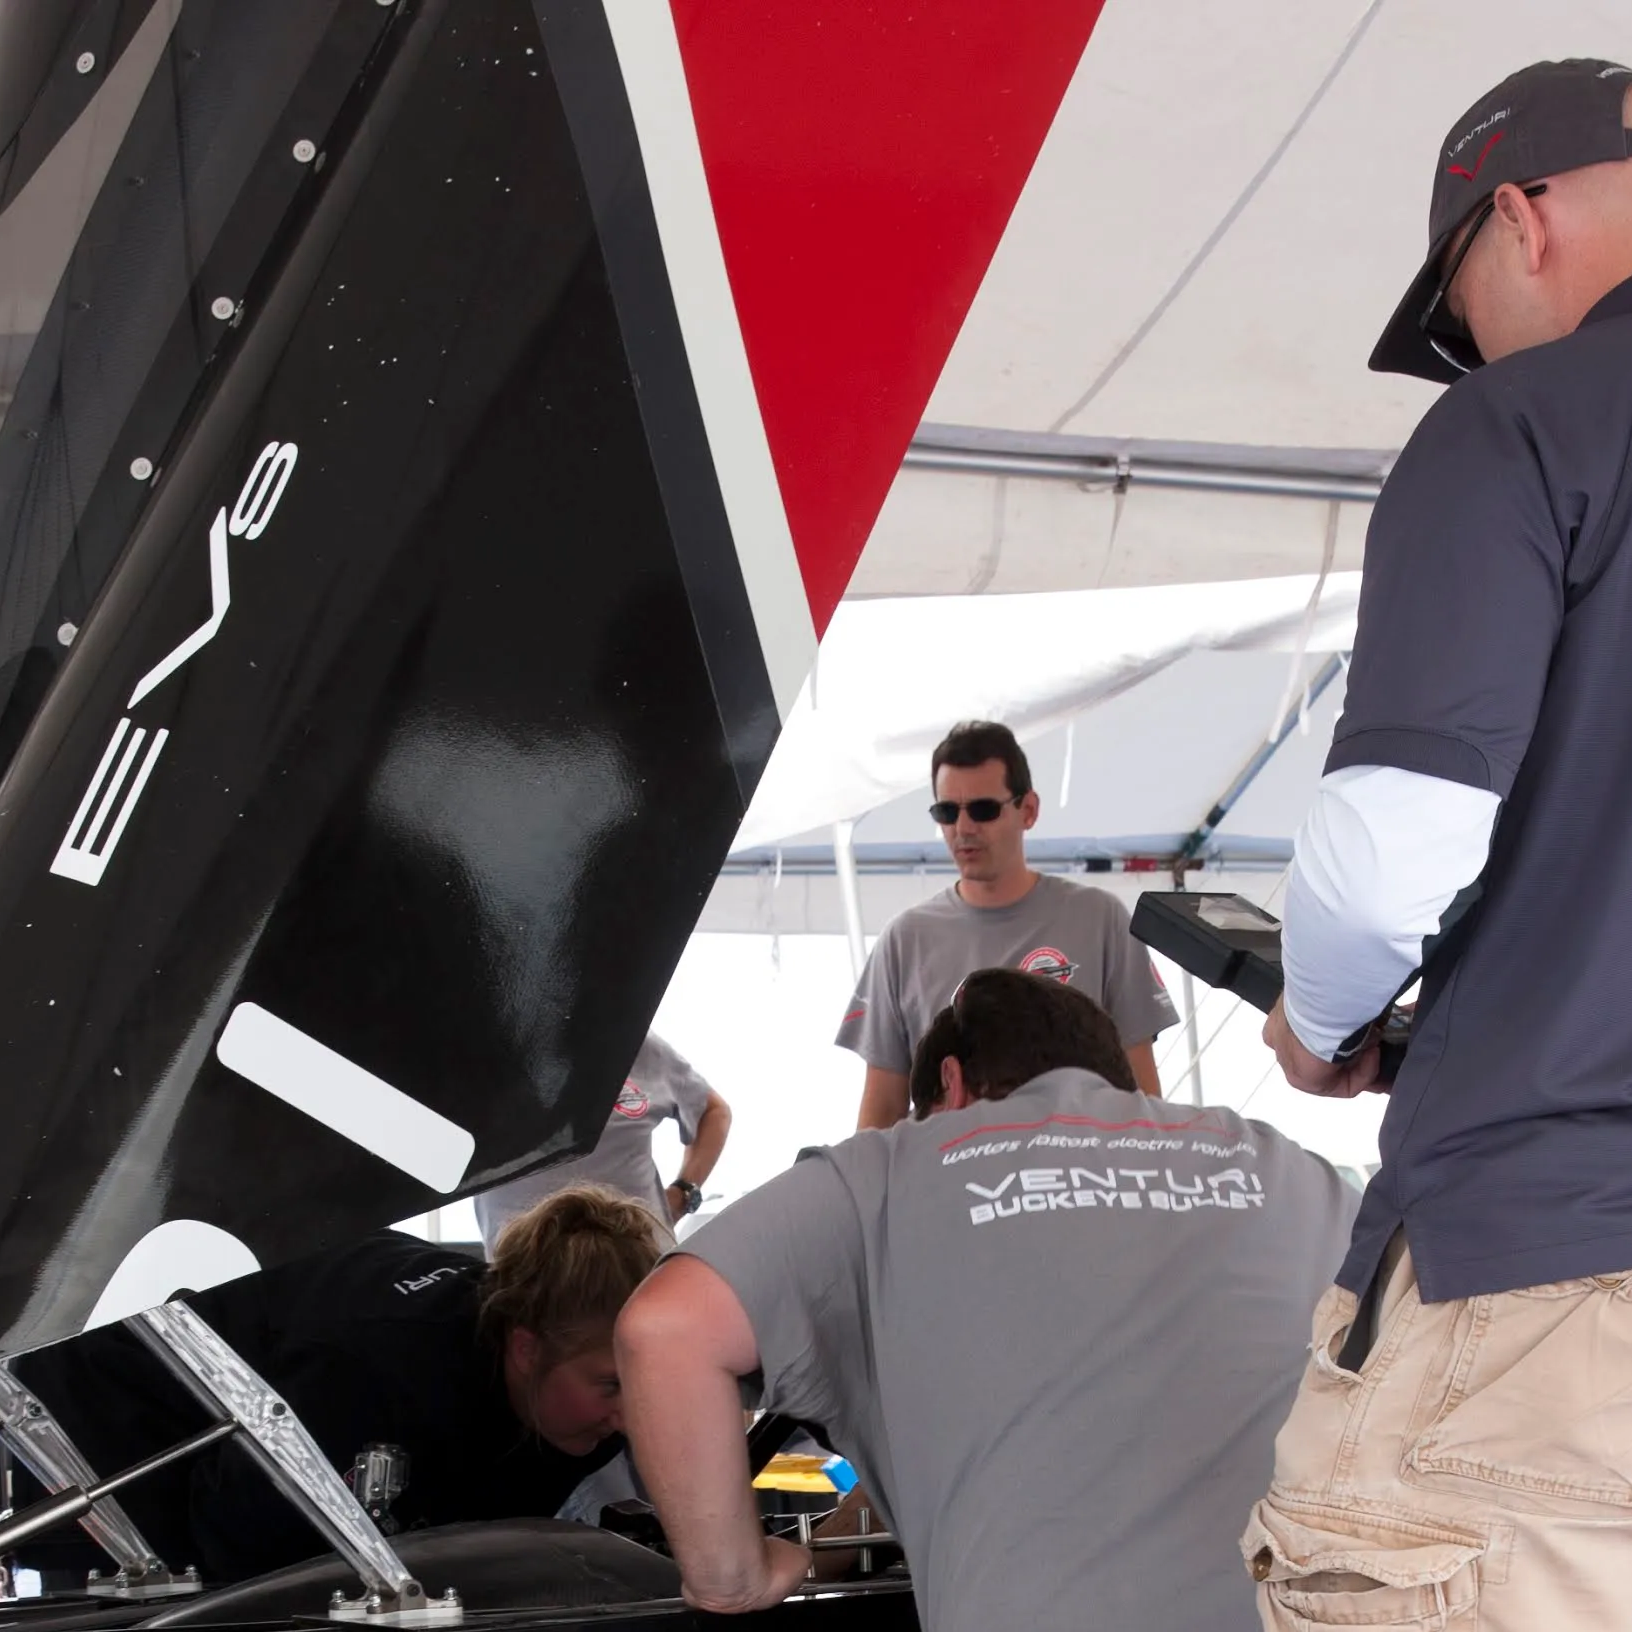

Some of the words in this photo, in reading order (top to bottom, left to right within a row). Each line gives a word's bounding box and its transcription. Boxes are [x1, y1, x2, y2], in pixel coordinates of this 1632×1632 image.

[1447, 107, 1510, 158] VENTURI
[965, 1167, 1263, 1199] VENTURI
[969, 1189, 1143, 1226] BUCKEYE
[1147, 1190, 1265, 1213] BULLET
